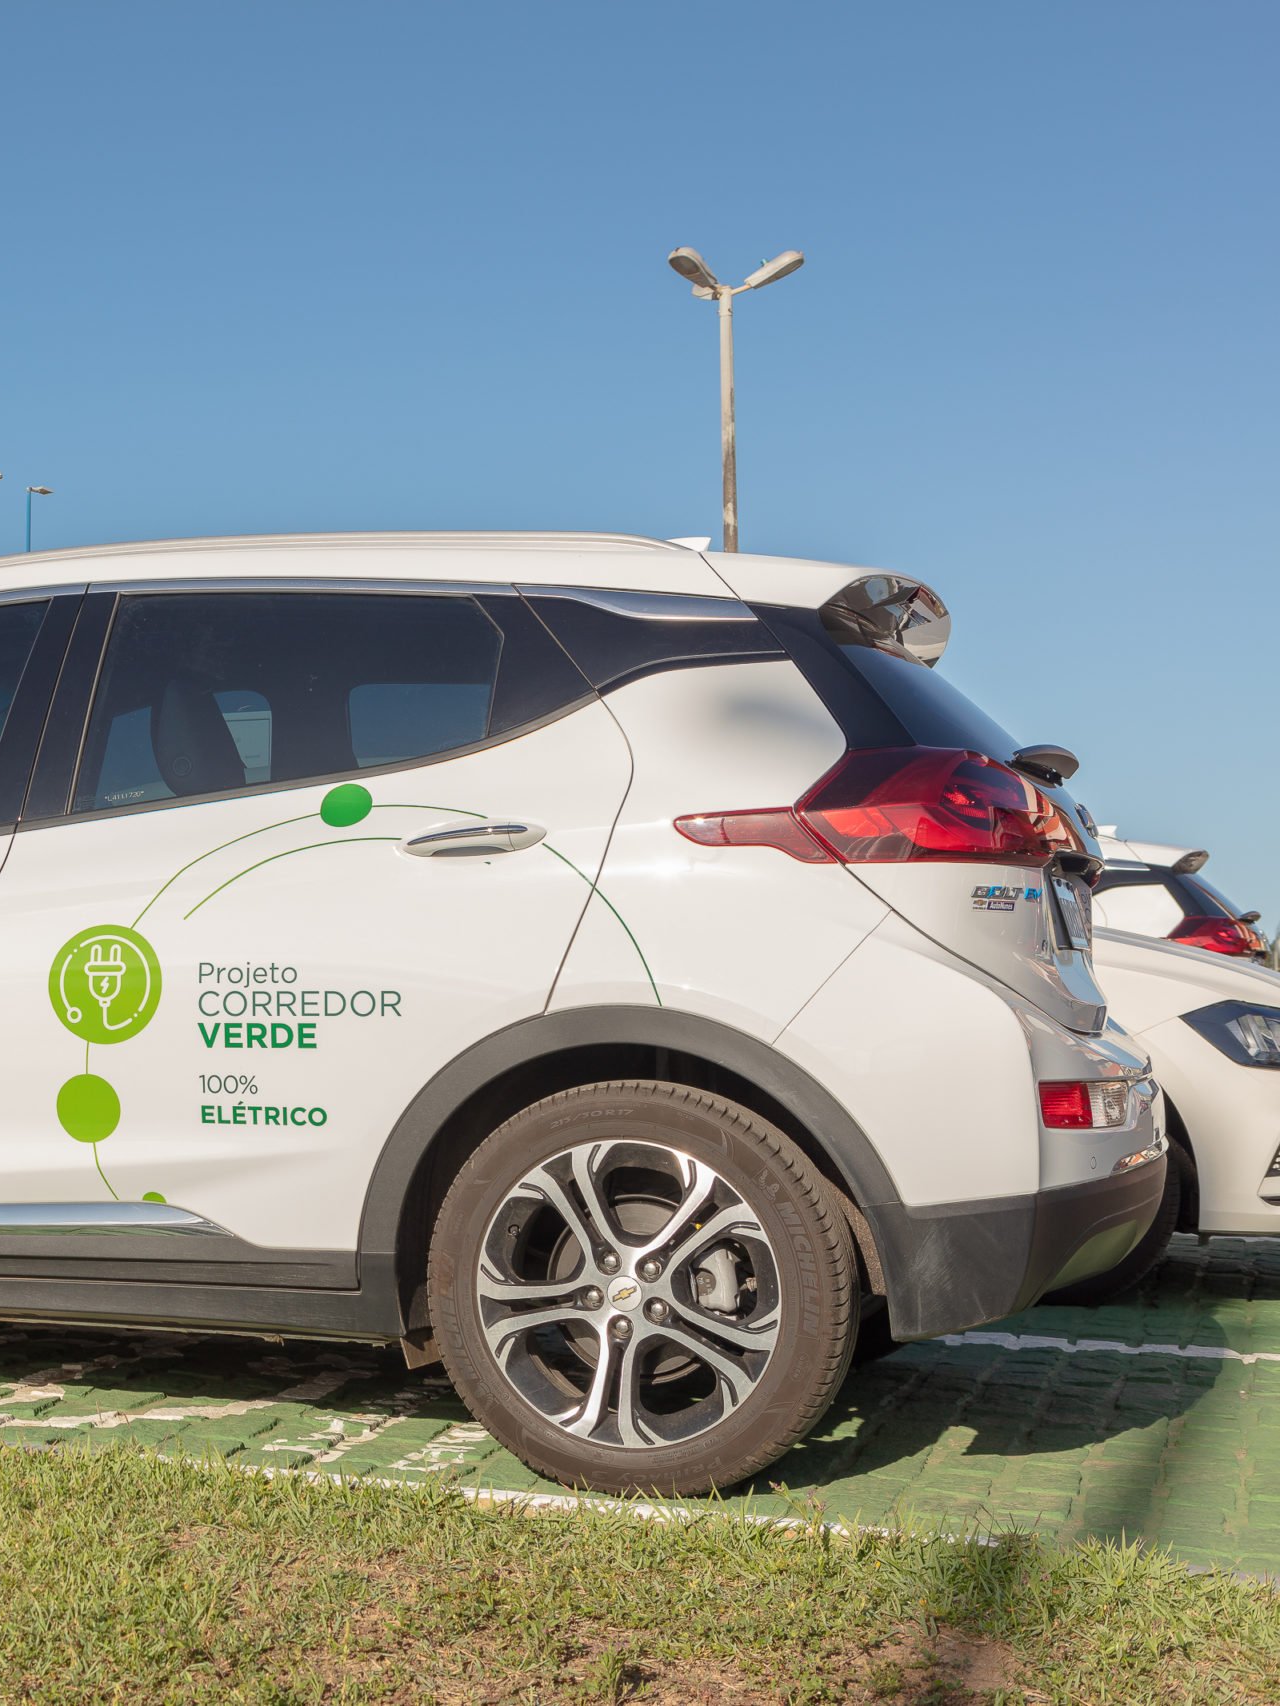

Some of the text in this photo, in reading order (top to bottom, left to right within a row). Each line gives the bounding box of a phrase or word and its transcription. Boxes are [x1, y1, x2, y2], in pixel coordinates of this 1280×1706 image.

[1024, 886, 1043, 900] EV
[198, 961, 298, 988] Projeto
[198, 990, 402, 1018] CORREDOR
[198, 1022, 318, 1049] VERDE
[199, 1074, 258, 1095] 100%
[200, 1100, 328, 1126] ELÉTRICO
[776, 1202, 822, 1336] MICHELIN
